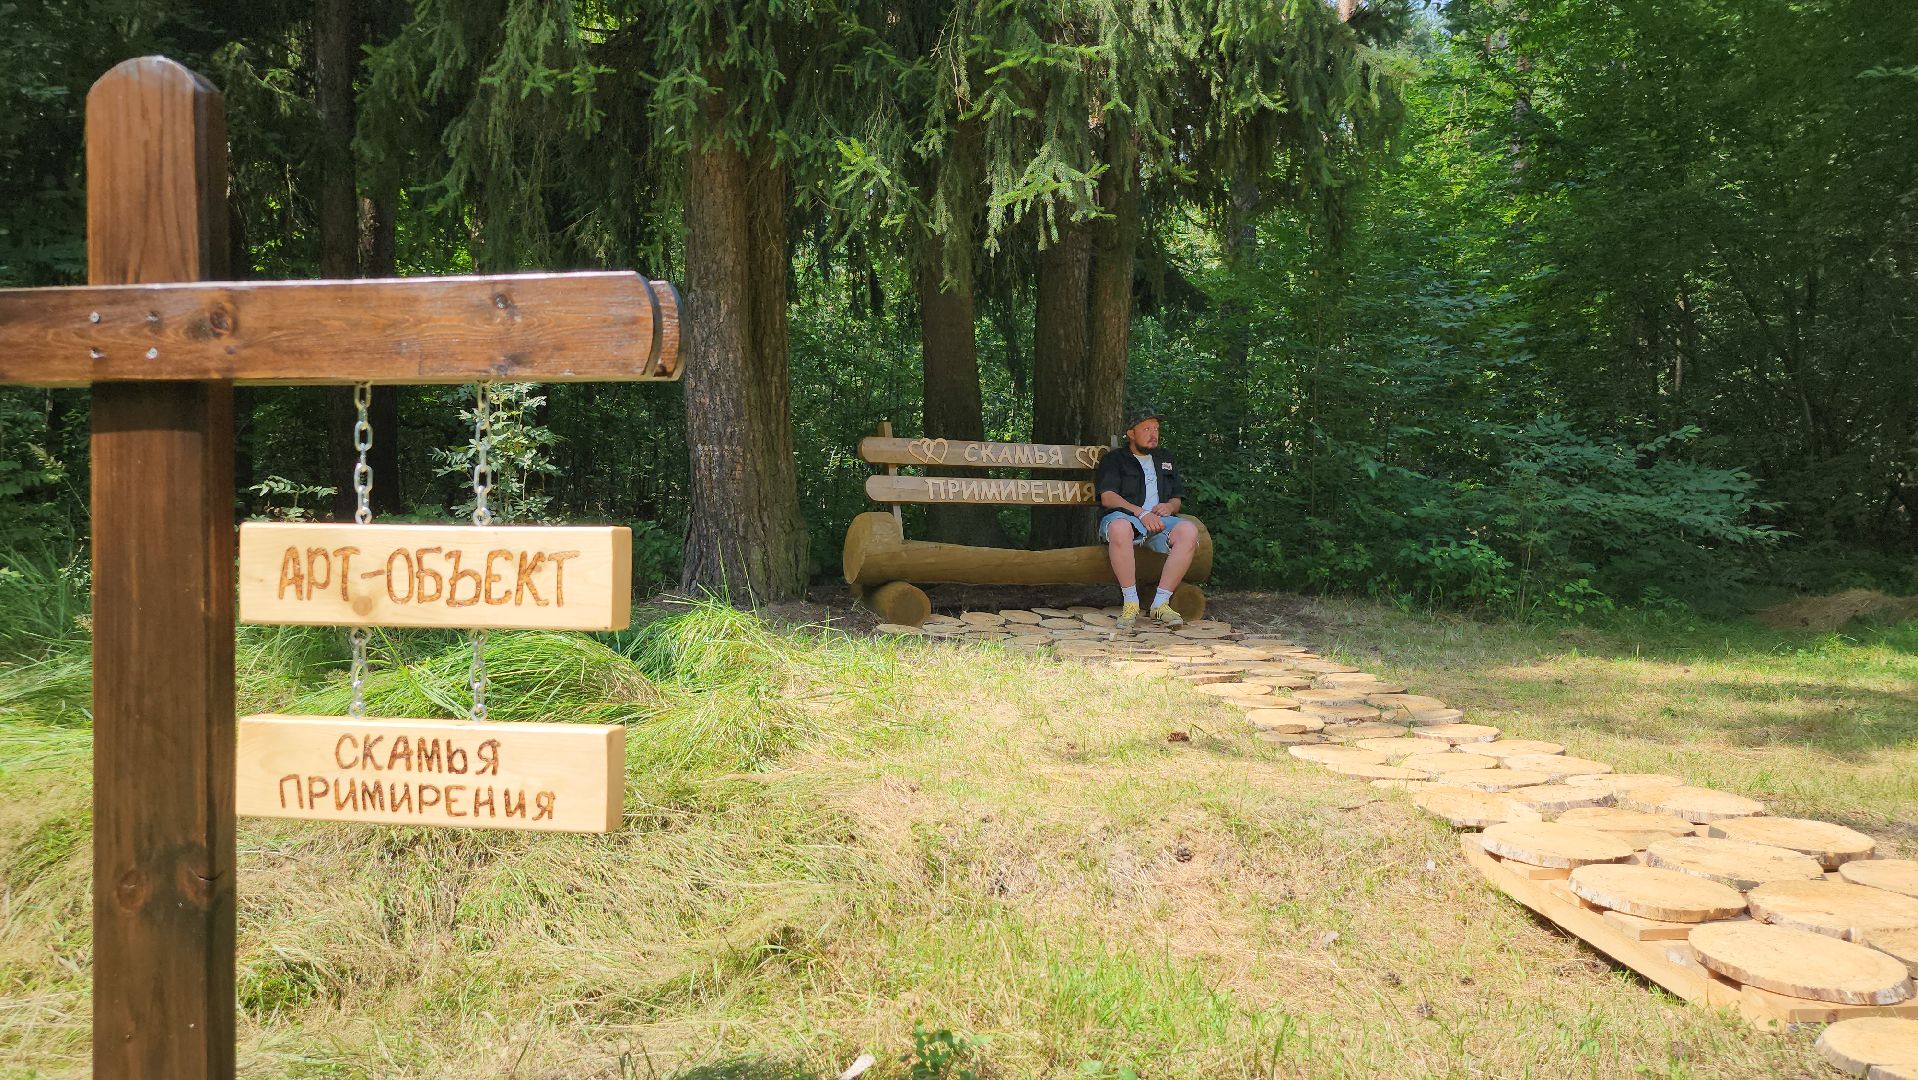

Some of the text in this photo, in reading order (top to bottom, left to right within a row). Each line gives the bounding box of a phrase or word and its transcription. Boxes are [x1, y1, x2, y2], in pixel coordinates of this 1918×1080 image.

[964, 443, 1064, 466] СКАМЬЯ
[924, 477, 1096, 504] ПРИМИРЕНИЯ
[278, 545, 580, 608] АРТ-ОБЪЕКТ
[334, 732, 502, 777] СКАМЬЯ
[279, 773, 556, 821] ПРИМИРЕНИЯ
